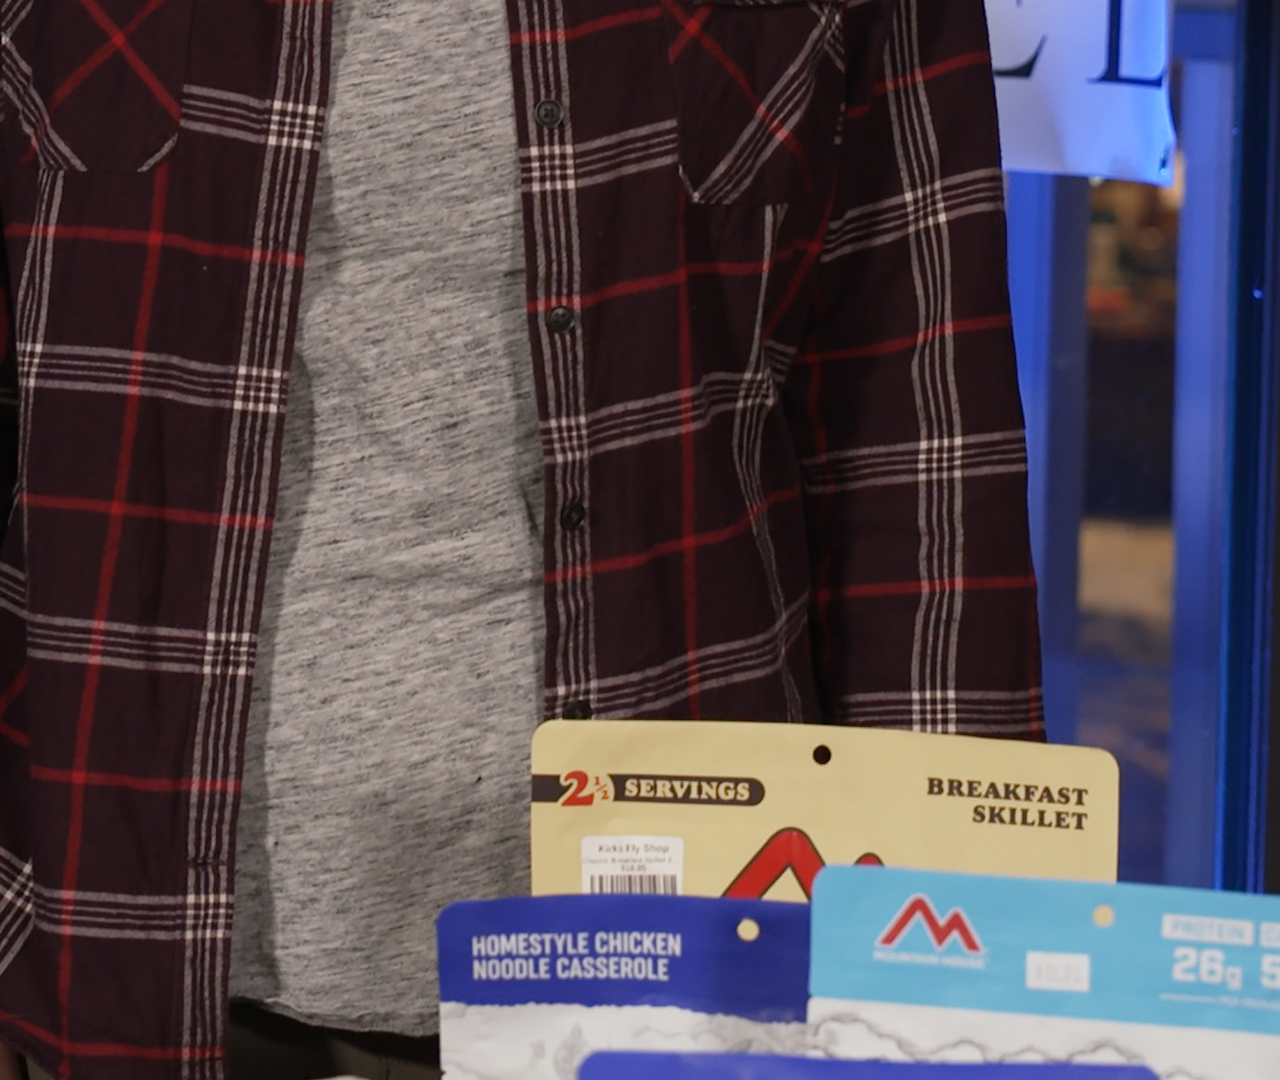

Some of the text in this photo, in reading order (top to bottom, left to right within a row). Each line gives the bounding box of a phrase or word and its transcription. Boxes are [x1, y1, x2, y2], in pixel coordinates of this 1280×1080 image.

[624, 778, 751, 801] SERVINGS
[927, 776, 1088, 806] BREAKFAST
[972, 804, 1088, 830] SKILLET
[1171, 916, 1245, 938] PROTEIN
[472, 931, 682, 957] HOMESTYLE CHICKEN
[473, 956, 669, 981] NOODLE CASSEROLE
[1172, 946, 1243, 991] 26g
